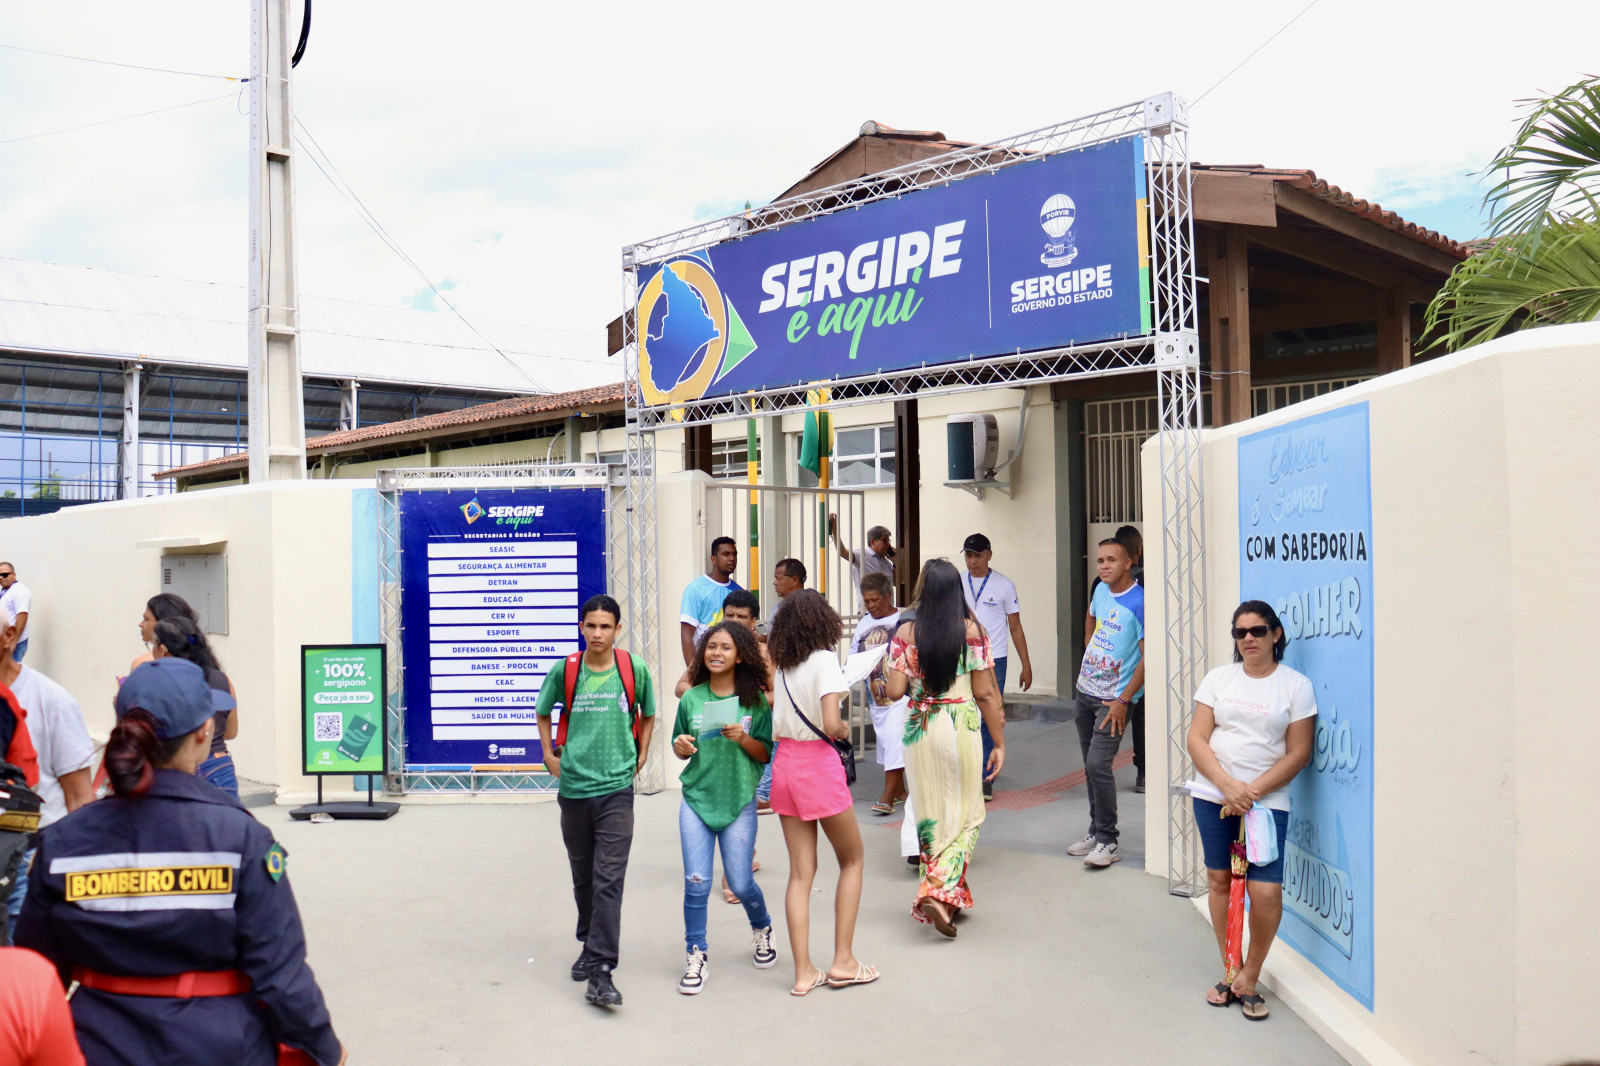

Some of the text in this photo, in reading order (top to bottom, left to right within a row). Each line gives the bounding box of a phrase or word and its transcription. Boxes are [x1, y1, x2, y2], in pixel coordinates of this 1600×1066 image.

[1046, 209, 1070, 220] PORVIR
[758, 219, 967, 314] SERGIPE
[1010, 263, 1113, 304] SERGIPE
[1011, 287, 1113, 314] GOVERNO DO ESTADO
[786, 267, 924, 360] é aqui
[487, 505, 545, 518] SERGIPE
[505, 513, 535, 530] aqui
[1246, 531, 1367, 562] COM SABEDORIA
[457, 563, 503, 571] SEGURANÇA
[483, 595, 524, 604] EDUCAÇÃO
[491, 612, 506, 620] CER
[500, 644, 532, 653] PÚBLICA
[323, 663, 366, 678] 100%
[507, 662, 539, 670] PROCON
[323, 678, 367, 689] sergipano
[318, 694, 339, 702] Peça
[584, 705, 609, 713] Portugal
[471, 711, 496, 720] SAÚDE
[71, 867, 229, 897] BOMBEIRO CIVIL
